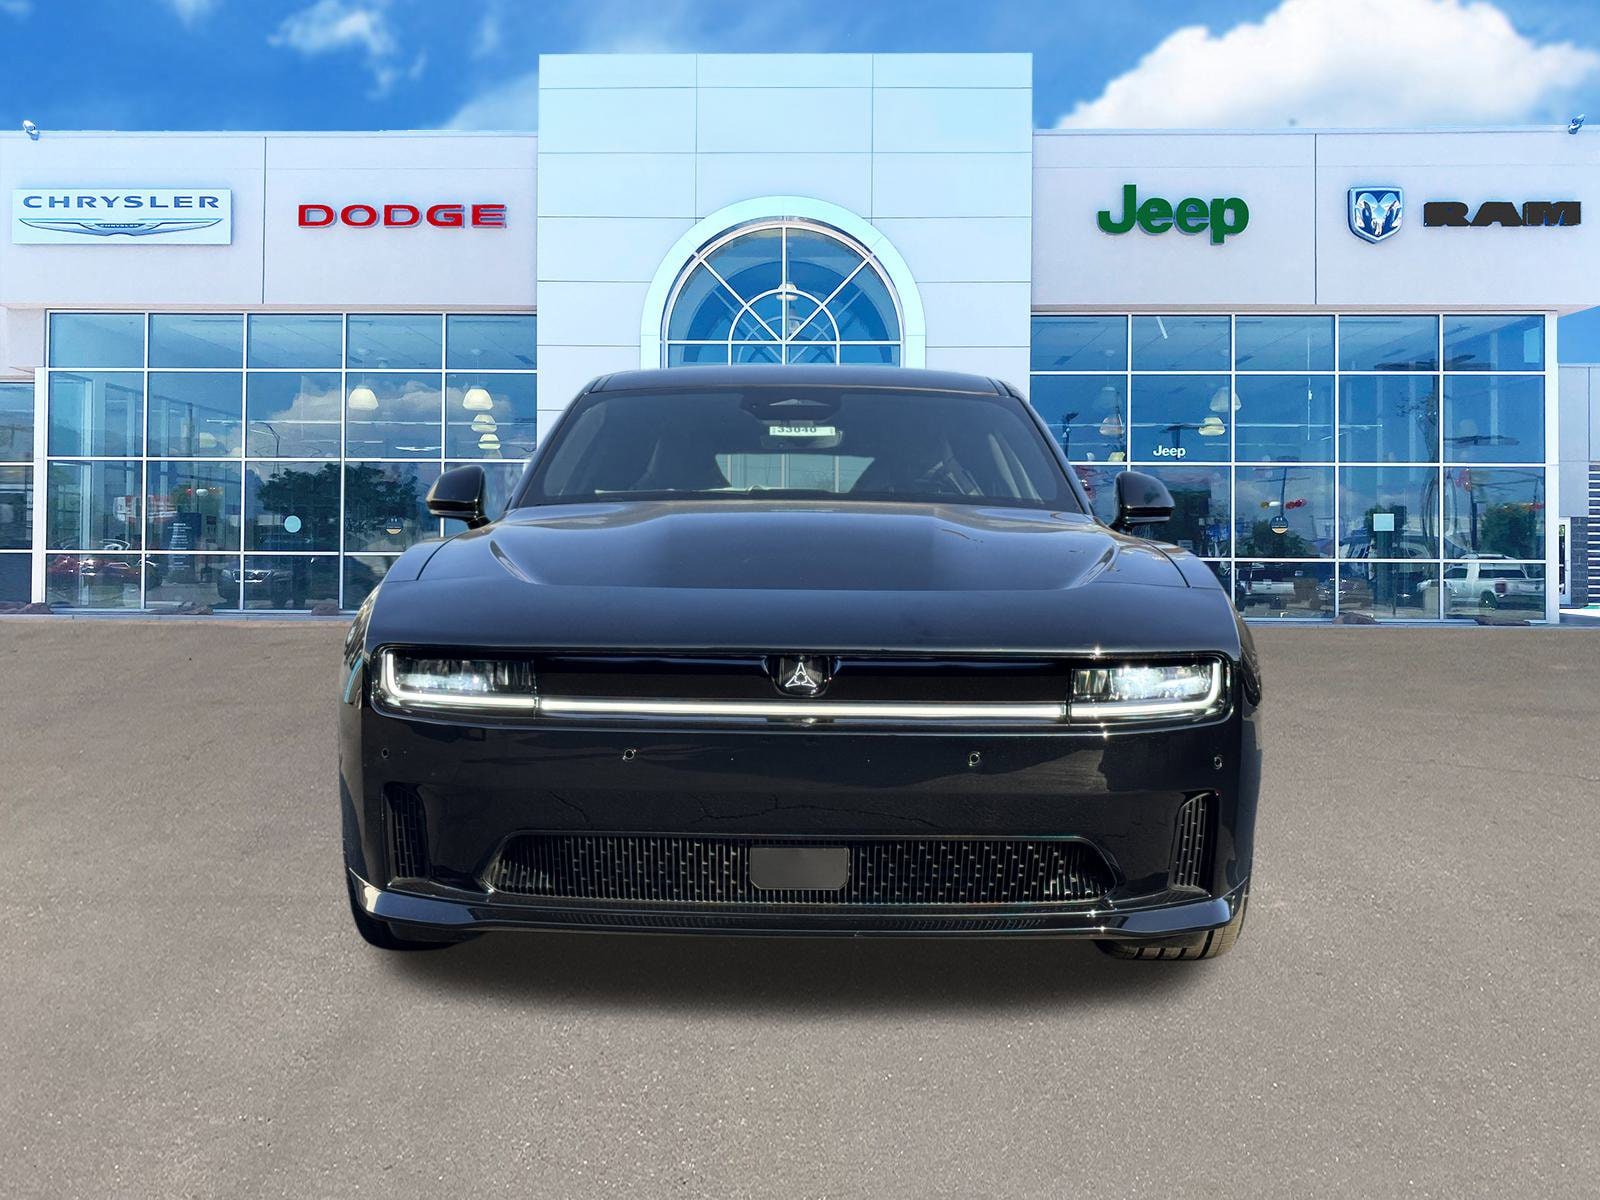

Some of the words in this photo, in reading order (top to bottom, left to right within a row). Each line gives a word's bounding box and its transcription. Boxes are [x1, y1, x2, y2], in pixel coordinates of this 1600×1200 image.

[22, 195, 220, 209] CHRYSLER
[1097, 184, 1250, 245] Jeep
[1423, 200, 1582, 227] RAM
[297, 203, 507, 229] DODGE
[1153, 445, 1186, 459] Jeep
